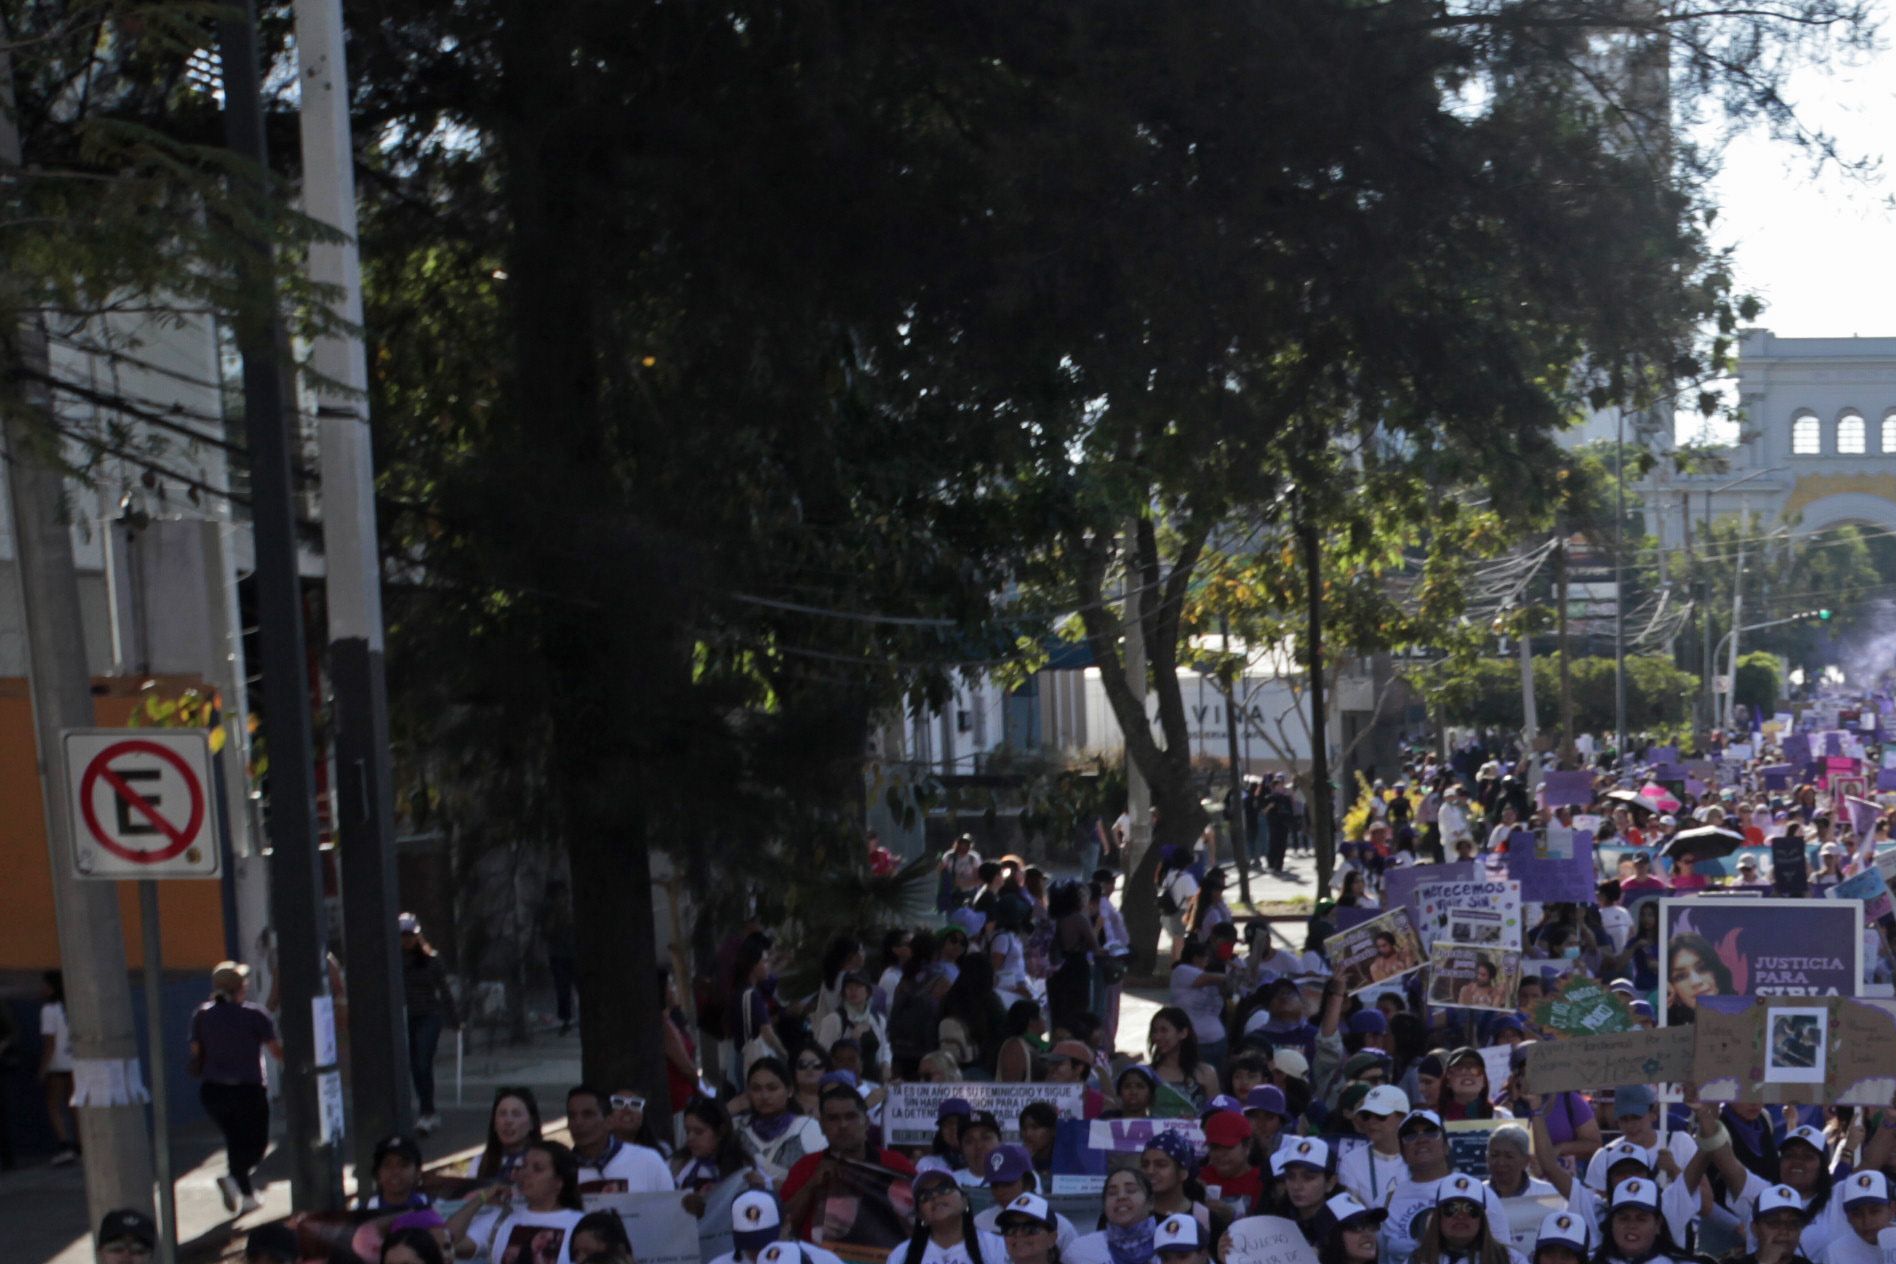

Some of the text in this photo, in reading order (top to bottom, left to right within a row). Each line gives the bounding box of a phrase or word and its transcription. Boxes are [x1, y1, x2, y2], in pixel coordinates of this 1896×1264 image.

[114, 768, 162, 836] E
[1754, 957, 1845, 970] JUSTICIA
[1754, 971, 1809, 984] PARA
[951, 1087, 964, 1098] DE
[1043, 1087, 1072, 1098] SIGUE
